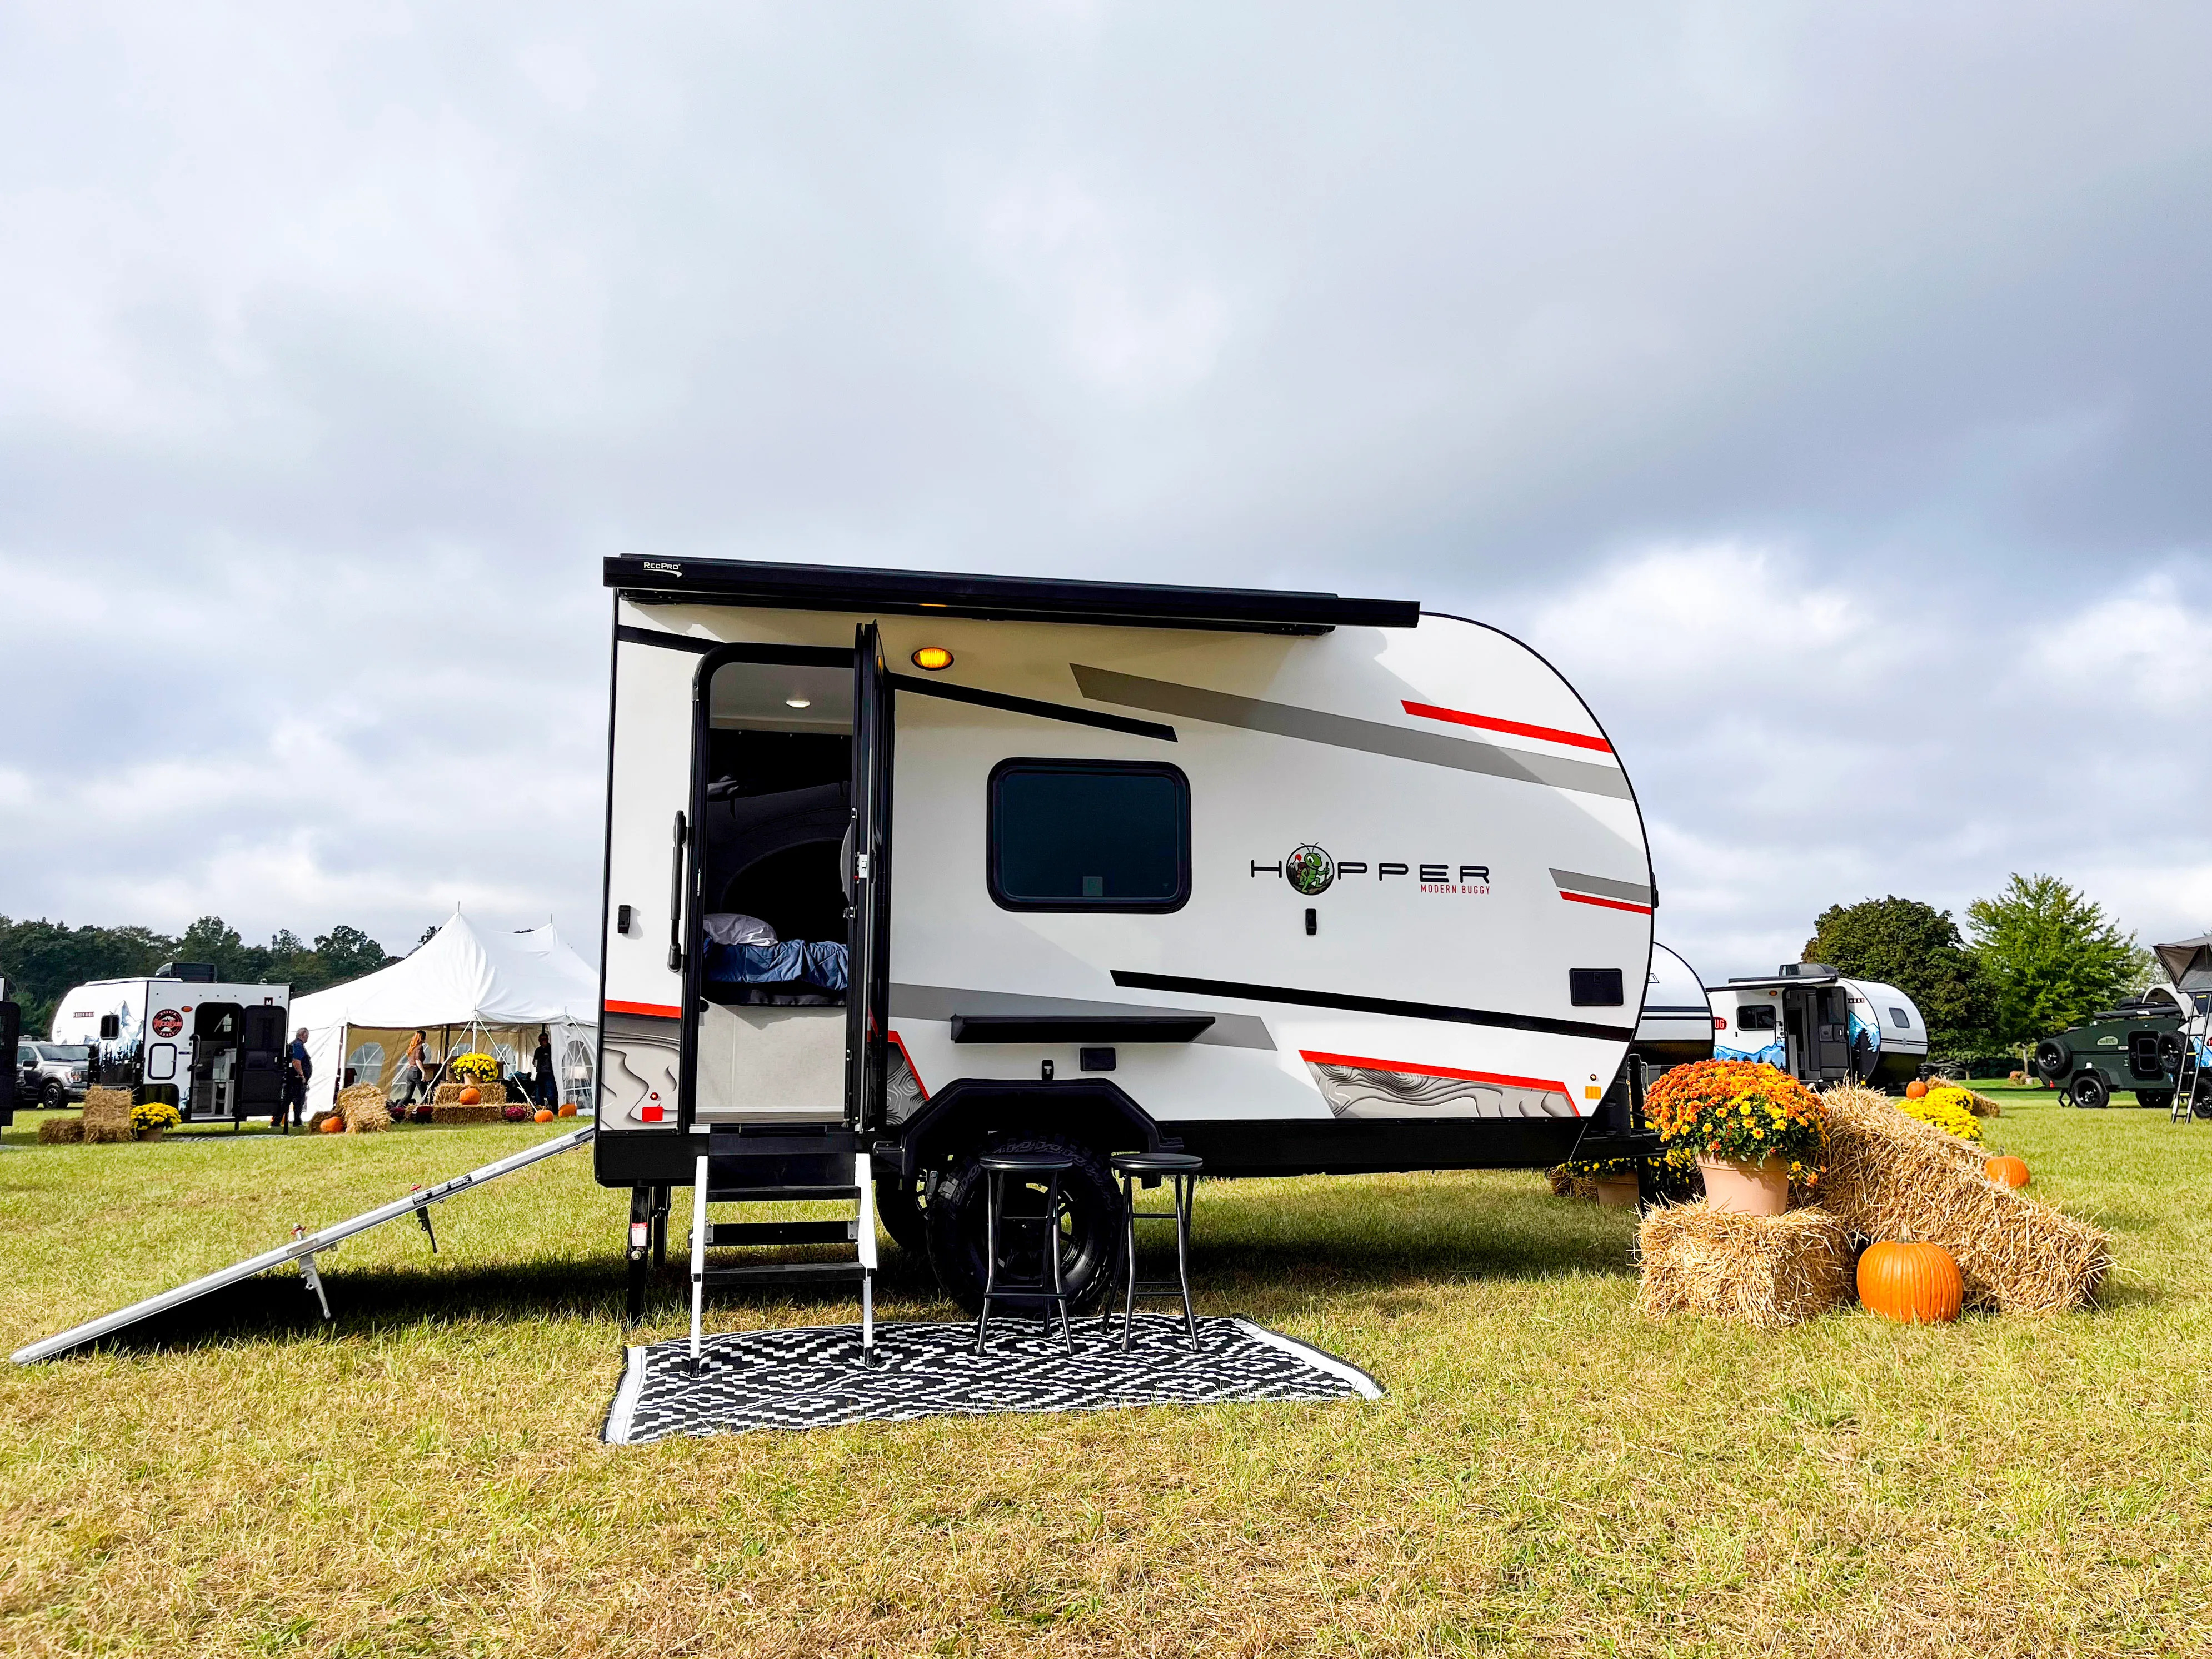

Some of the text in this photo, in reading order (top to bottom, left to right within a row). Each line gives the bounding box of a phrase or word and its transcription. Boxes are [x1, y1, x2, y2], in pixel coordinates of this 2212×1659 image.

[1420, 884, 1490, 894] MODERN BUGGY
[1714, 1019, 1724, 1029] UG
